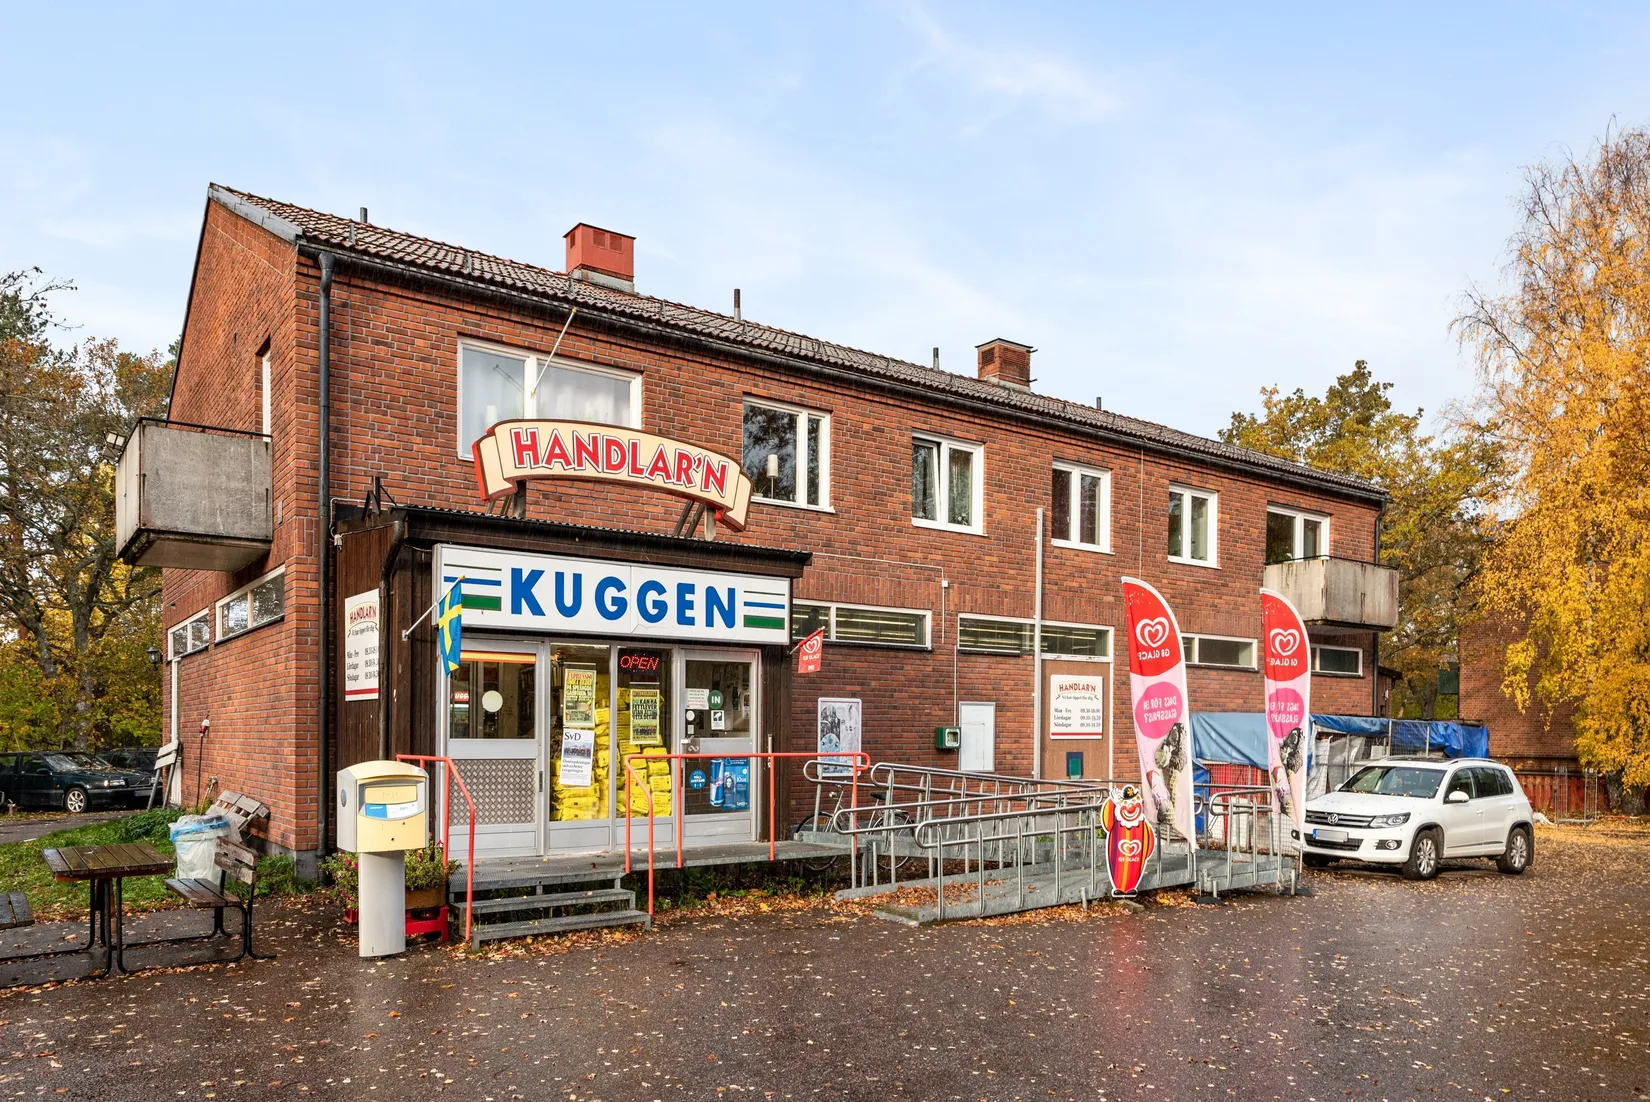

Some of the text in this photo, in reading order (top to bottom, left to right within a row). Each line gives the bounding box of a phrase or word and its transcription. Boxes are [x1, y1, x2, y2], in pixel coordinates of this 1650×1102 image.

[511, 567, 736, 629] KUGGEN
[620, 655, 659, 671] OPEN
[711, 696, 721, 704] IN
[565, 732, 582, 741] SvD
